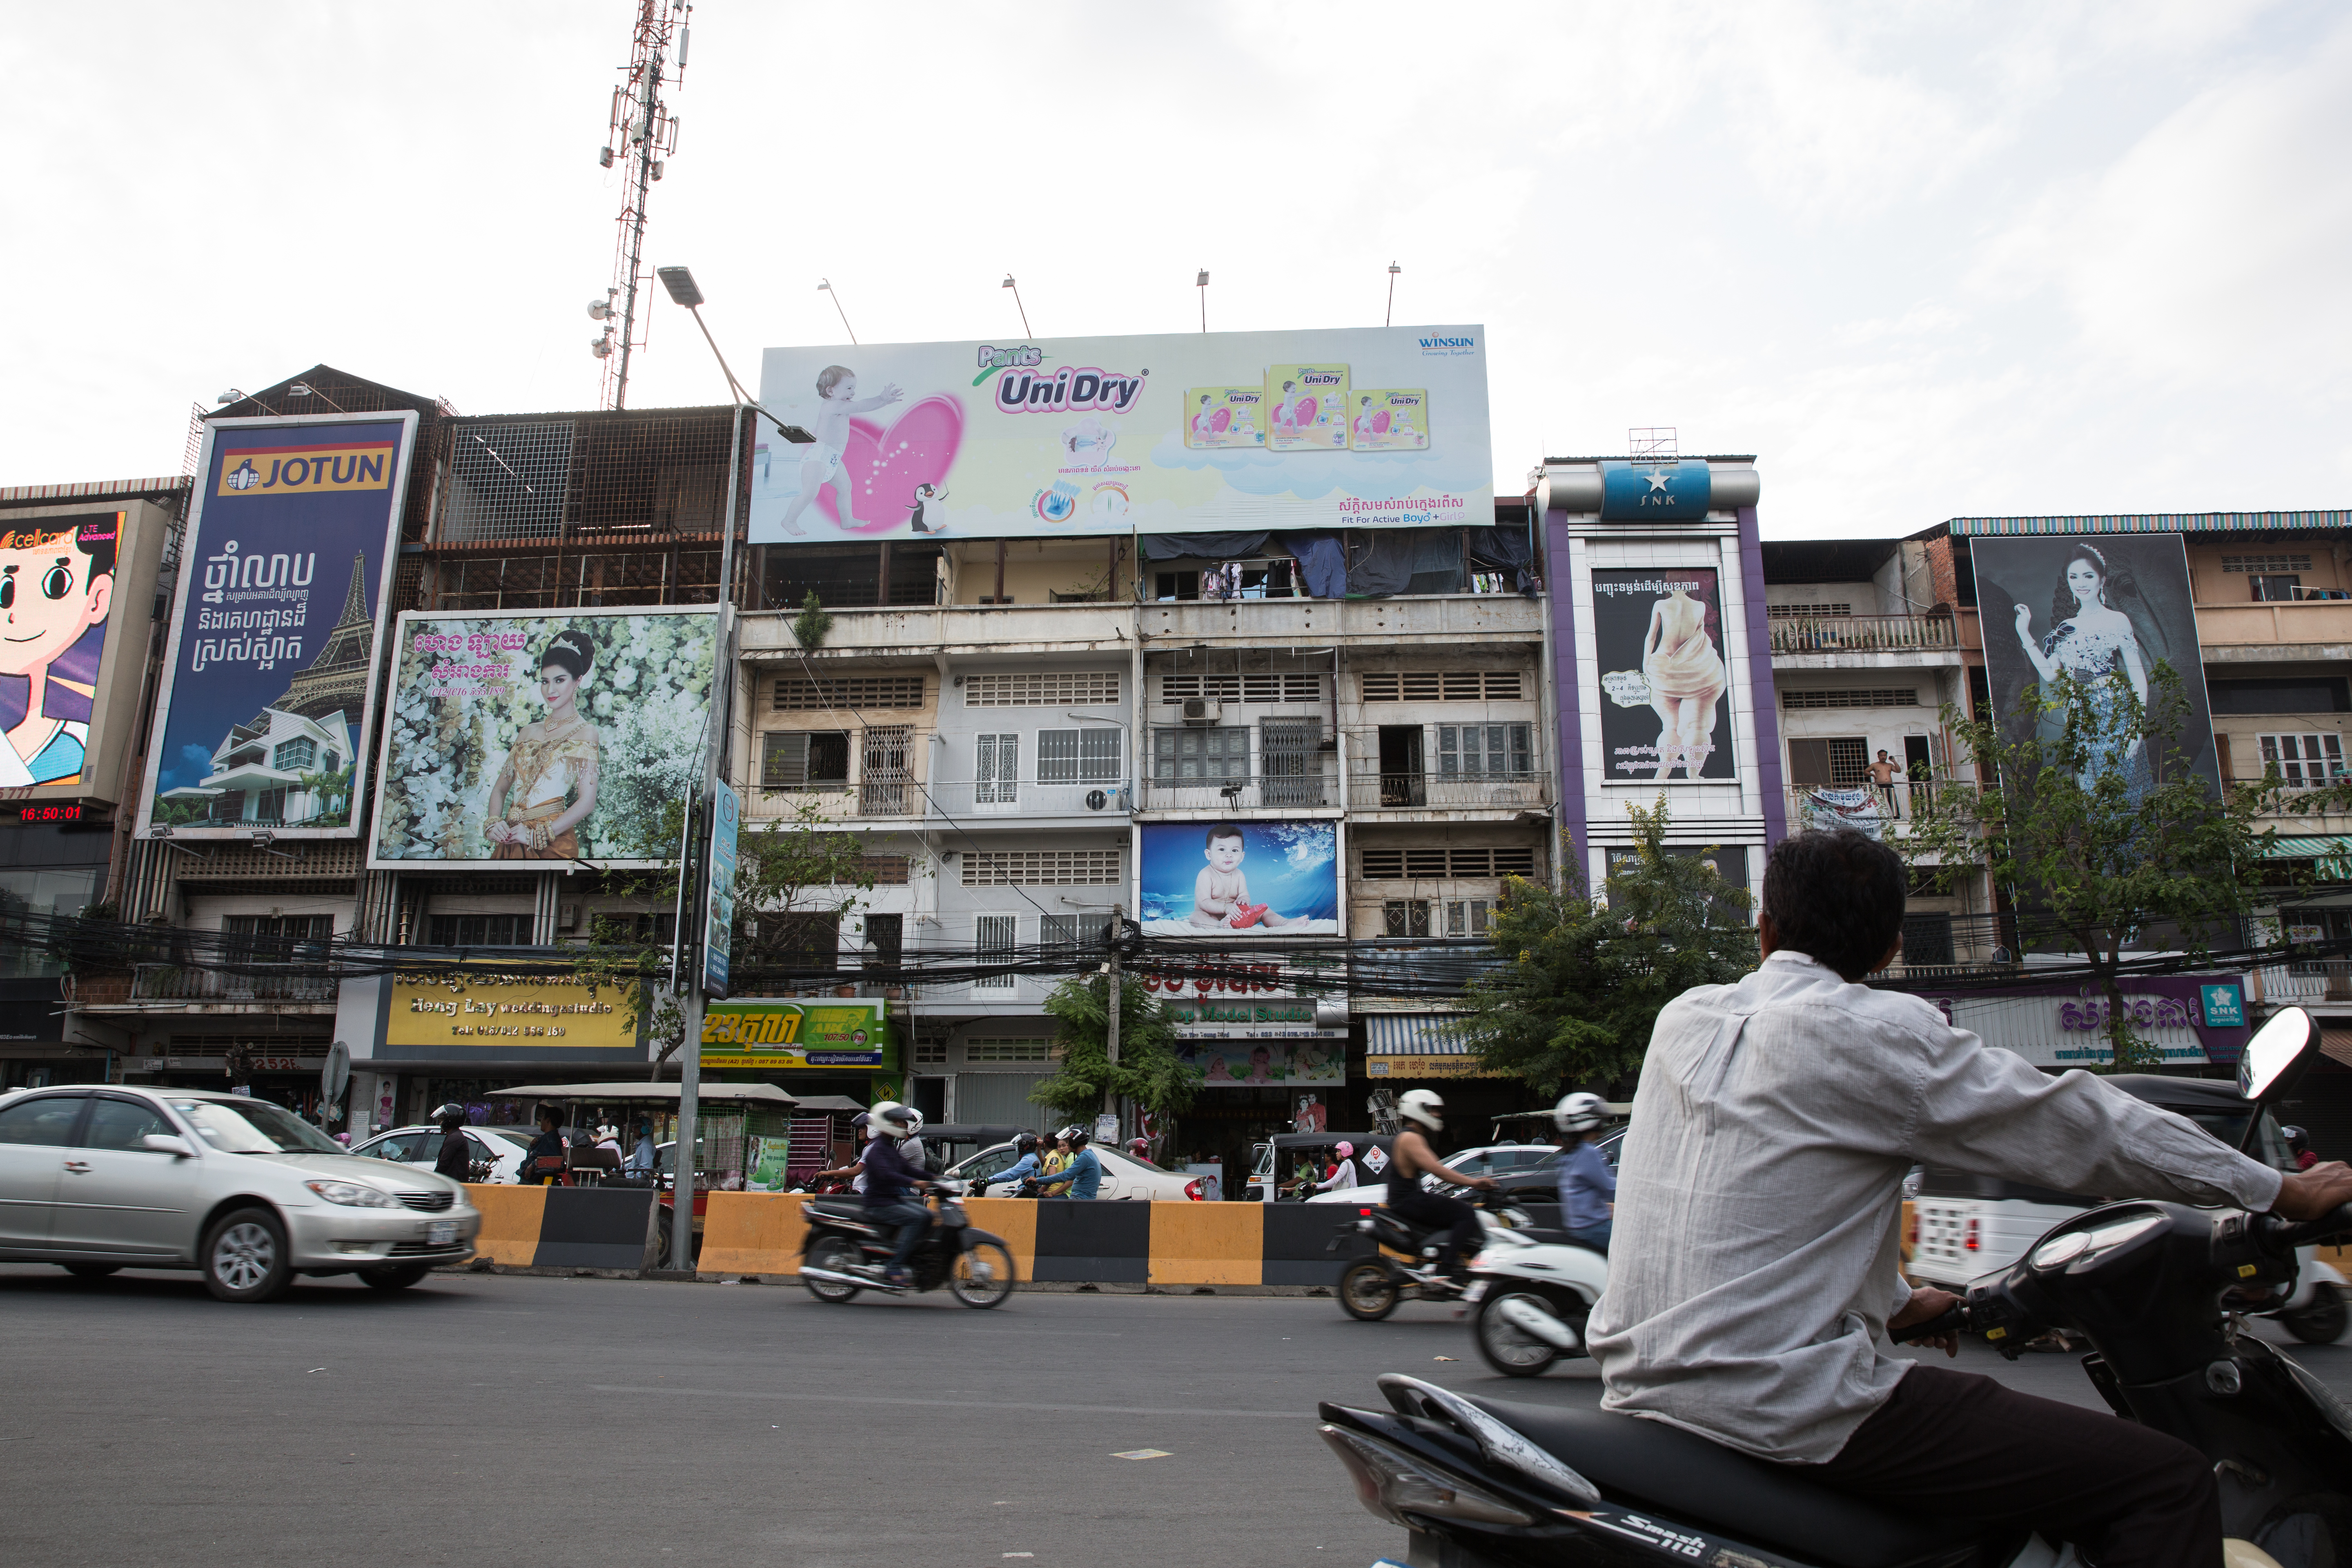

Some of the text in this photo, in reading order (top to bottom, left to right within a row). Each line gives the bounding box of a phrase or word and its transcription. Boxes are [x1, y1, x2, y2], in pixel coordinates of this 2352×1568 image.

[1419, 338, 1474, 347] WINSUN
[978, 345, 1042, 367] Pants
[262, 454, 384, 488] JOTUN
[1640, 495, 1675, 506] SNK
[1372, 515, 1400, 523] Active
[78, 531, 116, 541] Advanced
[84, 525, 98, 533] LTE
[15, 526, 75, 548] cellcard
[202, 540, 316, 604] ថ្នាំលាប
[414, 633, 463, 653] ហេង
[192, 632, 303, 672] ស្រស់ស្អាត
[470, 686, 488, 696] 555
[489, 686, 505, 696] 189
[8, 787, 34, 799] 777
[21, 806, 80, 820] 16:50:01
[411, 998, 458, 1017] Heng
[464, 998, 497, 1017] Lay
[1200, 1006, 1252, 1021] Model
[1255, 1006, 1312, 1021] Studio
[477, 1025, 519, 1036] 016/012
[523, 1026, 543, 1036] 555
[547, 1026, 566, 1036] 189
[810, 1022, 849, 1033] ABC
[824, 1033, 849, 1042] 107.50
[1620, 1515, 1706, 1549] Smash
[1661, 1538, 1702, 1558] 110
